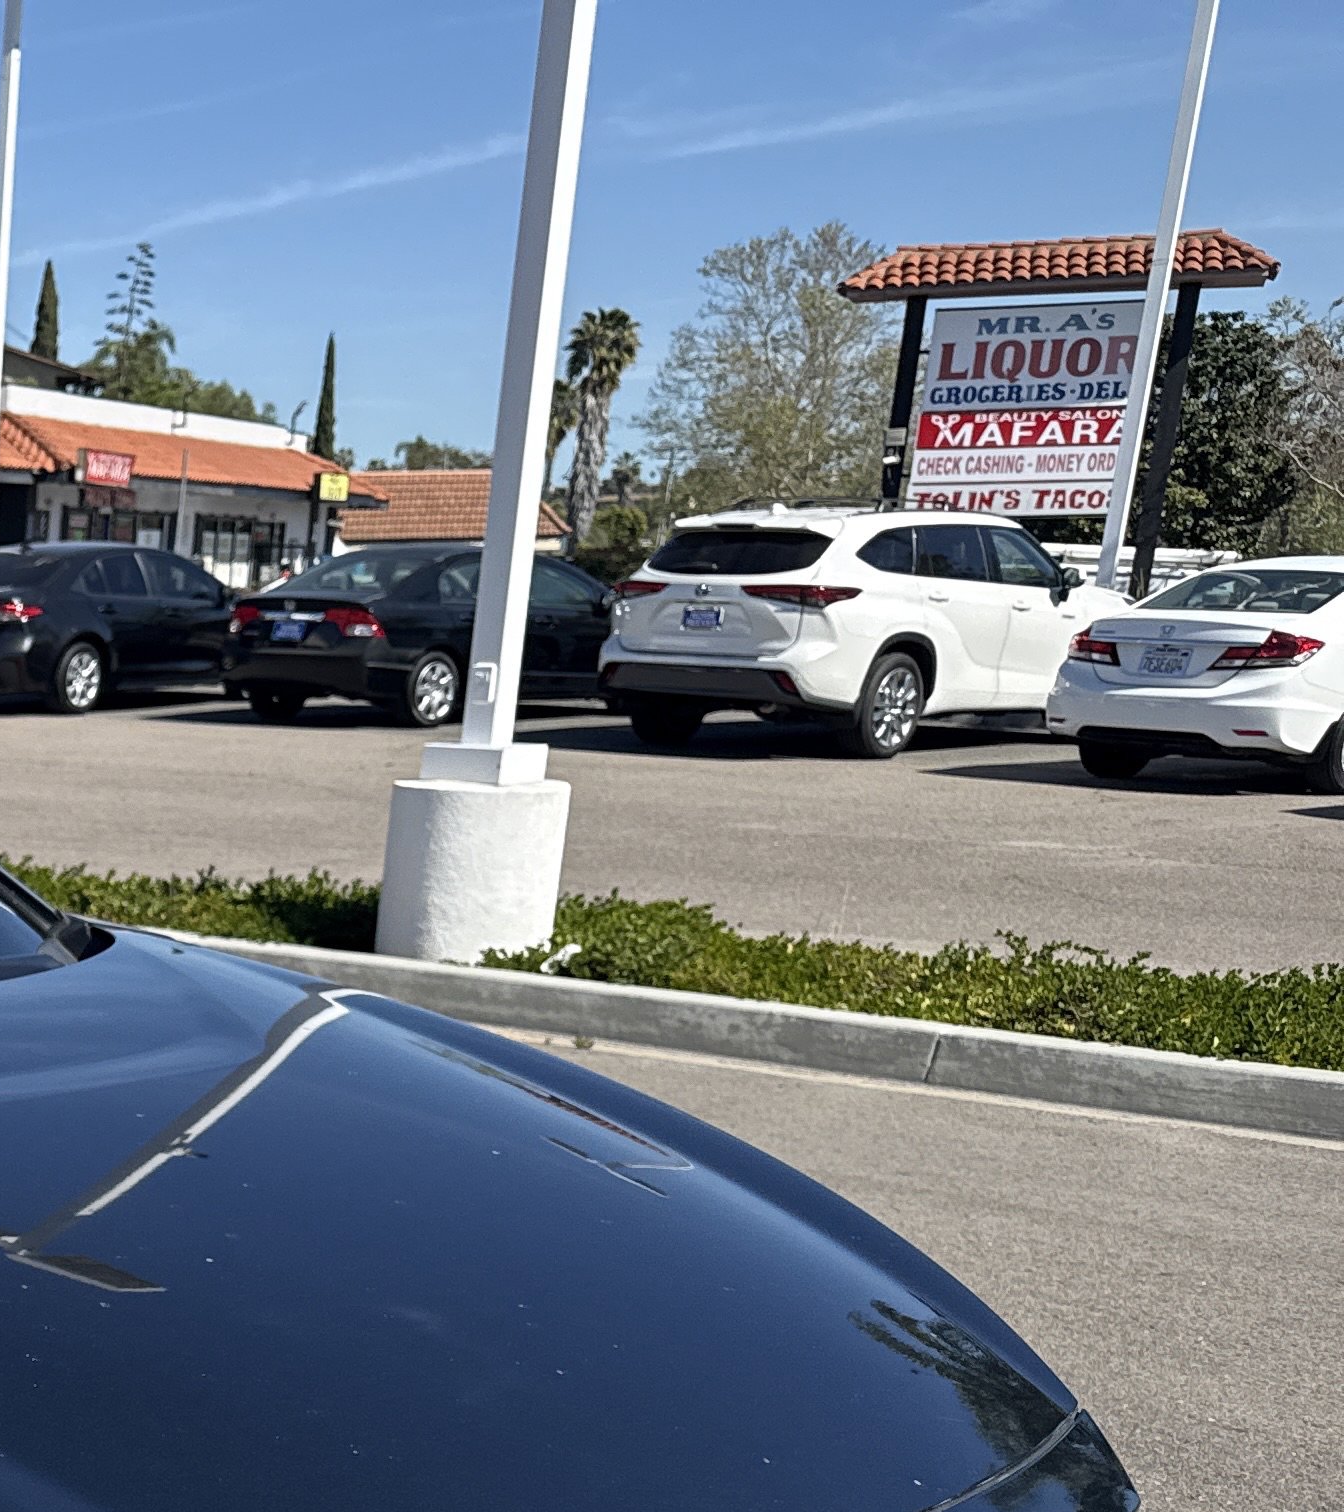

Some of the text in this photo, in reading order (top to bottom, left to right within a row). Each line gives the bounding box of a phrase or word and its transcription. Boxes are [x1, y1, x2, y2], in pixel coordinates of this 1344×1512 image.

[937, 335, 1137, 383] LIQUOR
[1079, 381, 1127, 400] DEL
[975, 409, 1126, 423] BEAUTY SALON
[934, 419, 1124, 447] MAFARA
[917, 456, 961, 475] CHECK
[965, 455, 1024, 474] CASHING
[1035, 454, 1085, 473] MONEY
[1088, 452, 1116, 471] ORD
